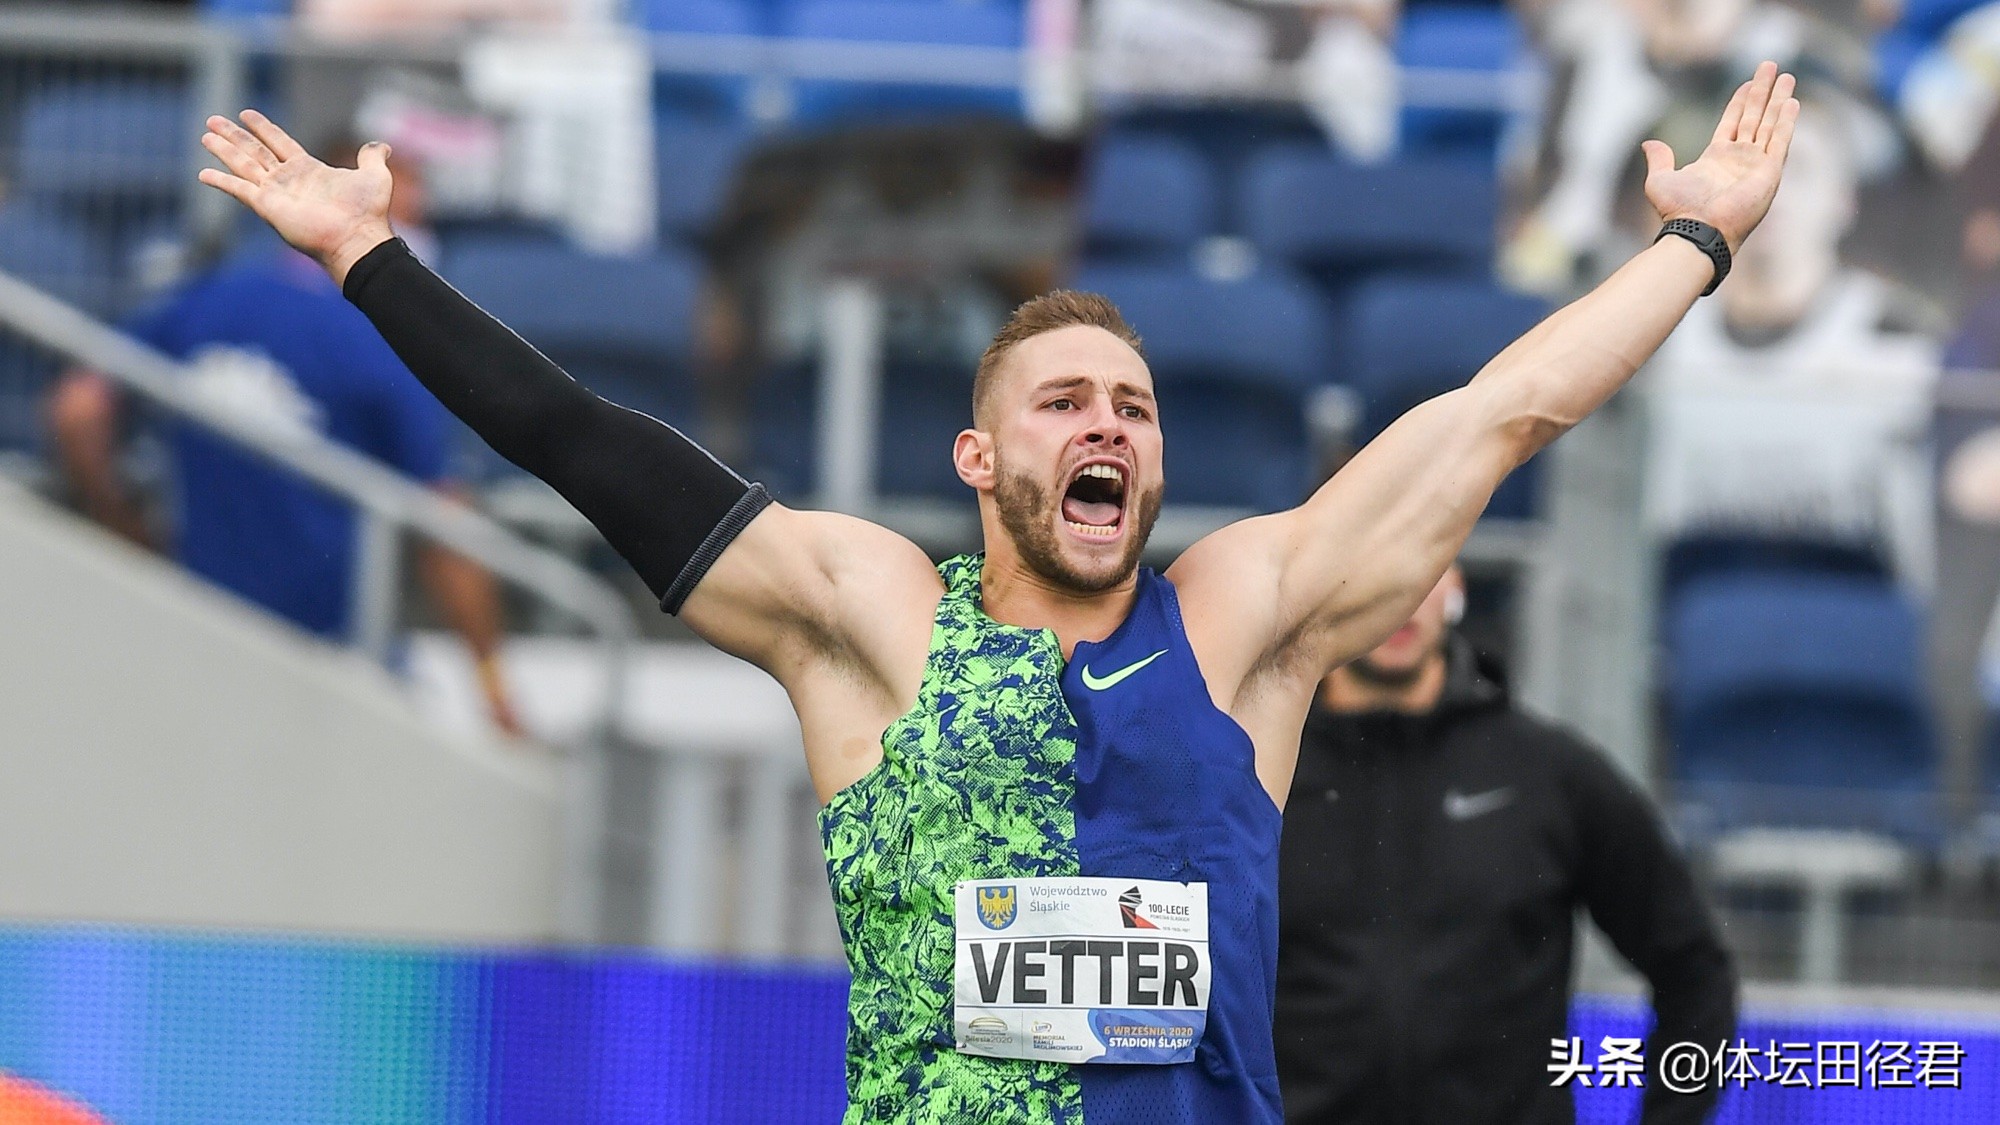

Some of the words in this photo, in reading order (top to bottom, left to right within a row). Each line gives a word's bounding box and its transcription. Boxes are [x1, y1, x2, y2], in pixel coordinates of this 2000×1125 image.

[1029, 886, 1108, 898] Województwo
[1029, 899, 1070, 914] Śląskie
[1148, 903, 1190, 916] 100-LECIE
[969, 940, 1199, 1007] VETTER
[1104, 1026, 1110, 1035] 6
[1114, 1024, 1167, 1036] WRZEŚNIA
[1169, 1027, 1193, 1037] 2020
[1109, 1037, 1156, 1048] STADION
